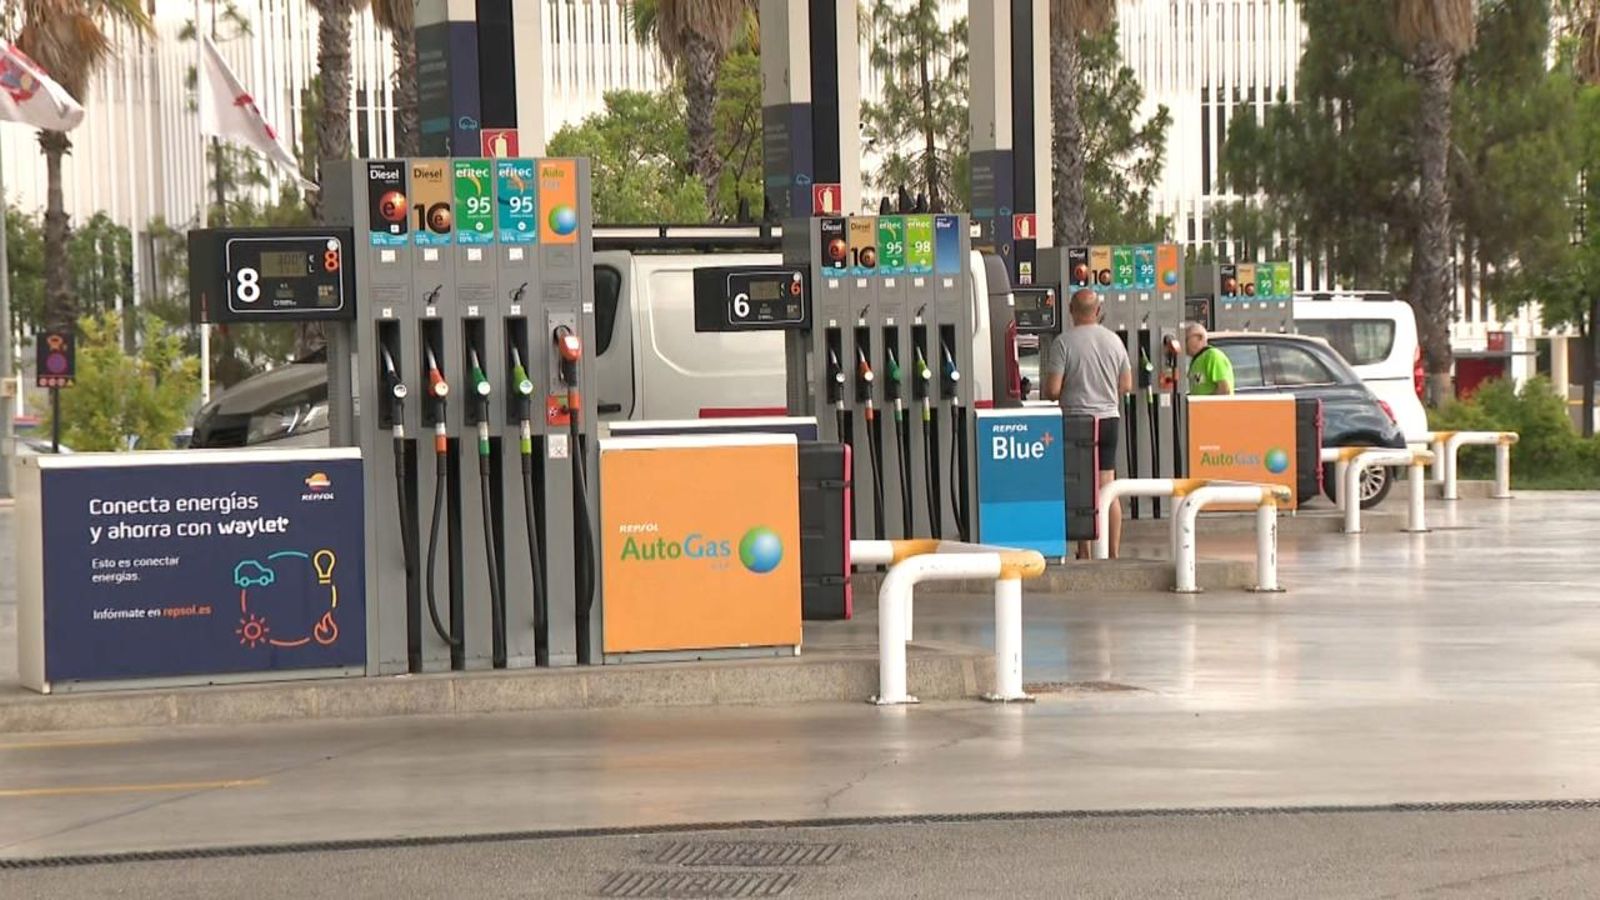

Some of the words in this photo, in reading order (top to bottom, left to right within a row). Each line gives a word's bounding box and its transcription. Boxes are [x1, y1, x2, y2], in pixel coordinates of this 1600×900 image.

[370, 169, 400, 180] Diesel
[414, 168, 443, 178] Diesel
[456, 167, 489, 178] efitec
[499, 167, 532, 178] efitec
[467, 196, 491, 214] 95
[510, 196, 534, 213] 95
[886, 241, 903, 255] 95
[915, 240, 931, 253] 98
[326, 250, 339, 271] 8
[1119, 264, 1132, 275] 95
[1141, 264, 1154, 275] 95
[237, 267, 261, 303] 8
[734, 292, 750, 318] 6
[993, 424, 1028, 433] REPSOL
[89, 497, 171, 516] Conecta
[176, 491, 259, 516] energías
[90, 525, 103, 544] y
[108, 521, 172, 540] ahorra
[176, 523, 212, 537] con
[620, 532, 732, 562] AutoGas
[91, 556, 116, 569] Esto
[117, 558, 131, 569] es
[133, 555, 180, 568] conectar
[91, 568, 141, 585] energías.
[93, 606, 146, 621] Infórmate
[147, 608, 161, 618] en
[162, 604, 212, 621] repsol.es
